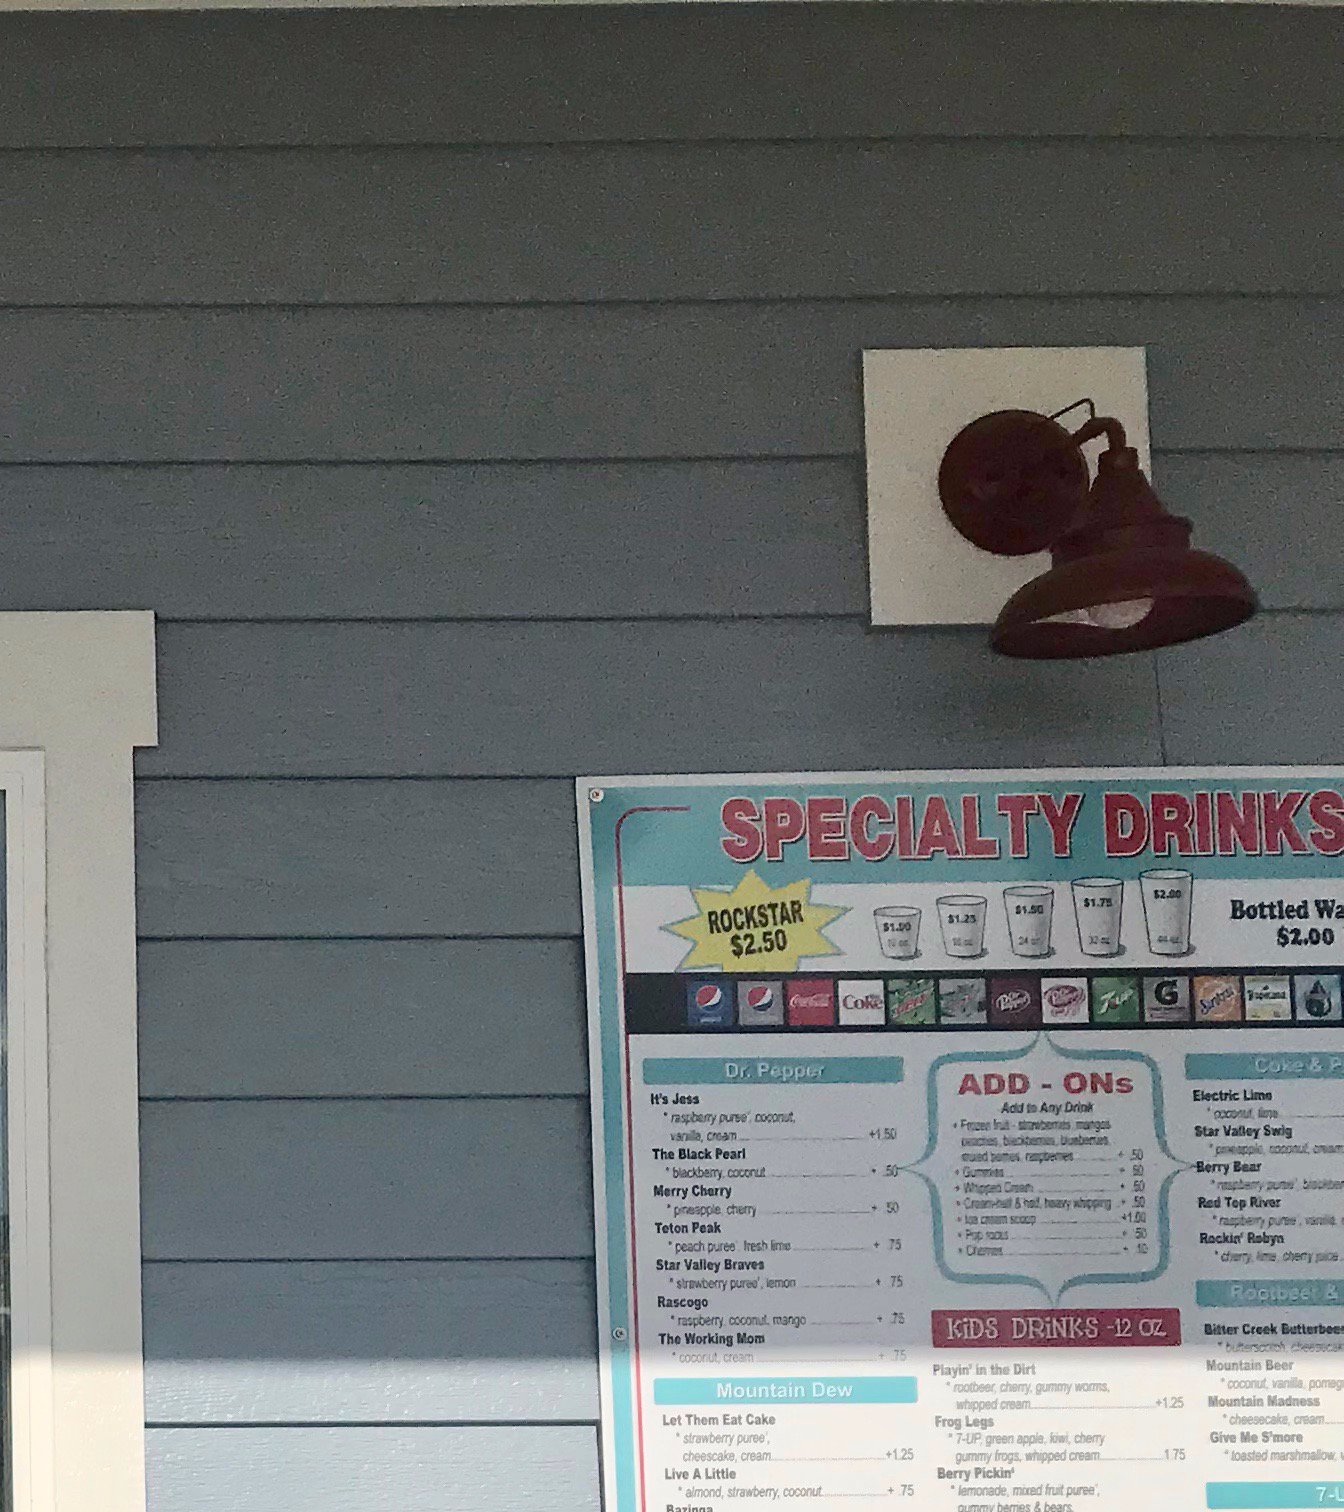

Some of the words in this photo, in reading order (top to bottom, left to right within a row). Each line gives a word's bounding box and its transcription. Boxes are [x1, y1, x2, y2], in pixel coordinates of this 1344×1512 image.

[719, 793, 1085, 863] SPECIALTY
[1103, 789, 1344, 859] DRINKS
[707, 902, 804, 935] ROCKSTAR
[1230, 899, 1310, 919] Bottled
[731, 929, 787, 959] $2.50
[1277, 925, 1334, 947] $2.00
[725, 1062, 755, 1080] Dr.
[758, 1063, 825, 1083] Pepper
[1139, 1319, 1168, 1337] OZ
[716, 1381, 805, 1400] Mountain
[811, 1381, 852, 1399] Dew
